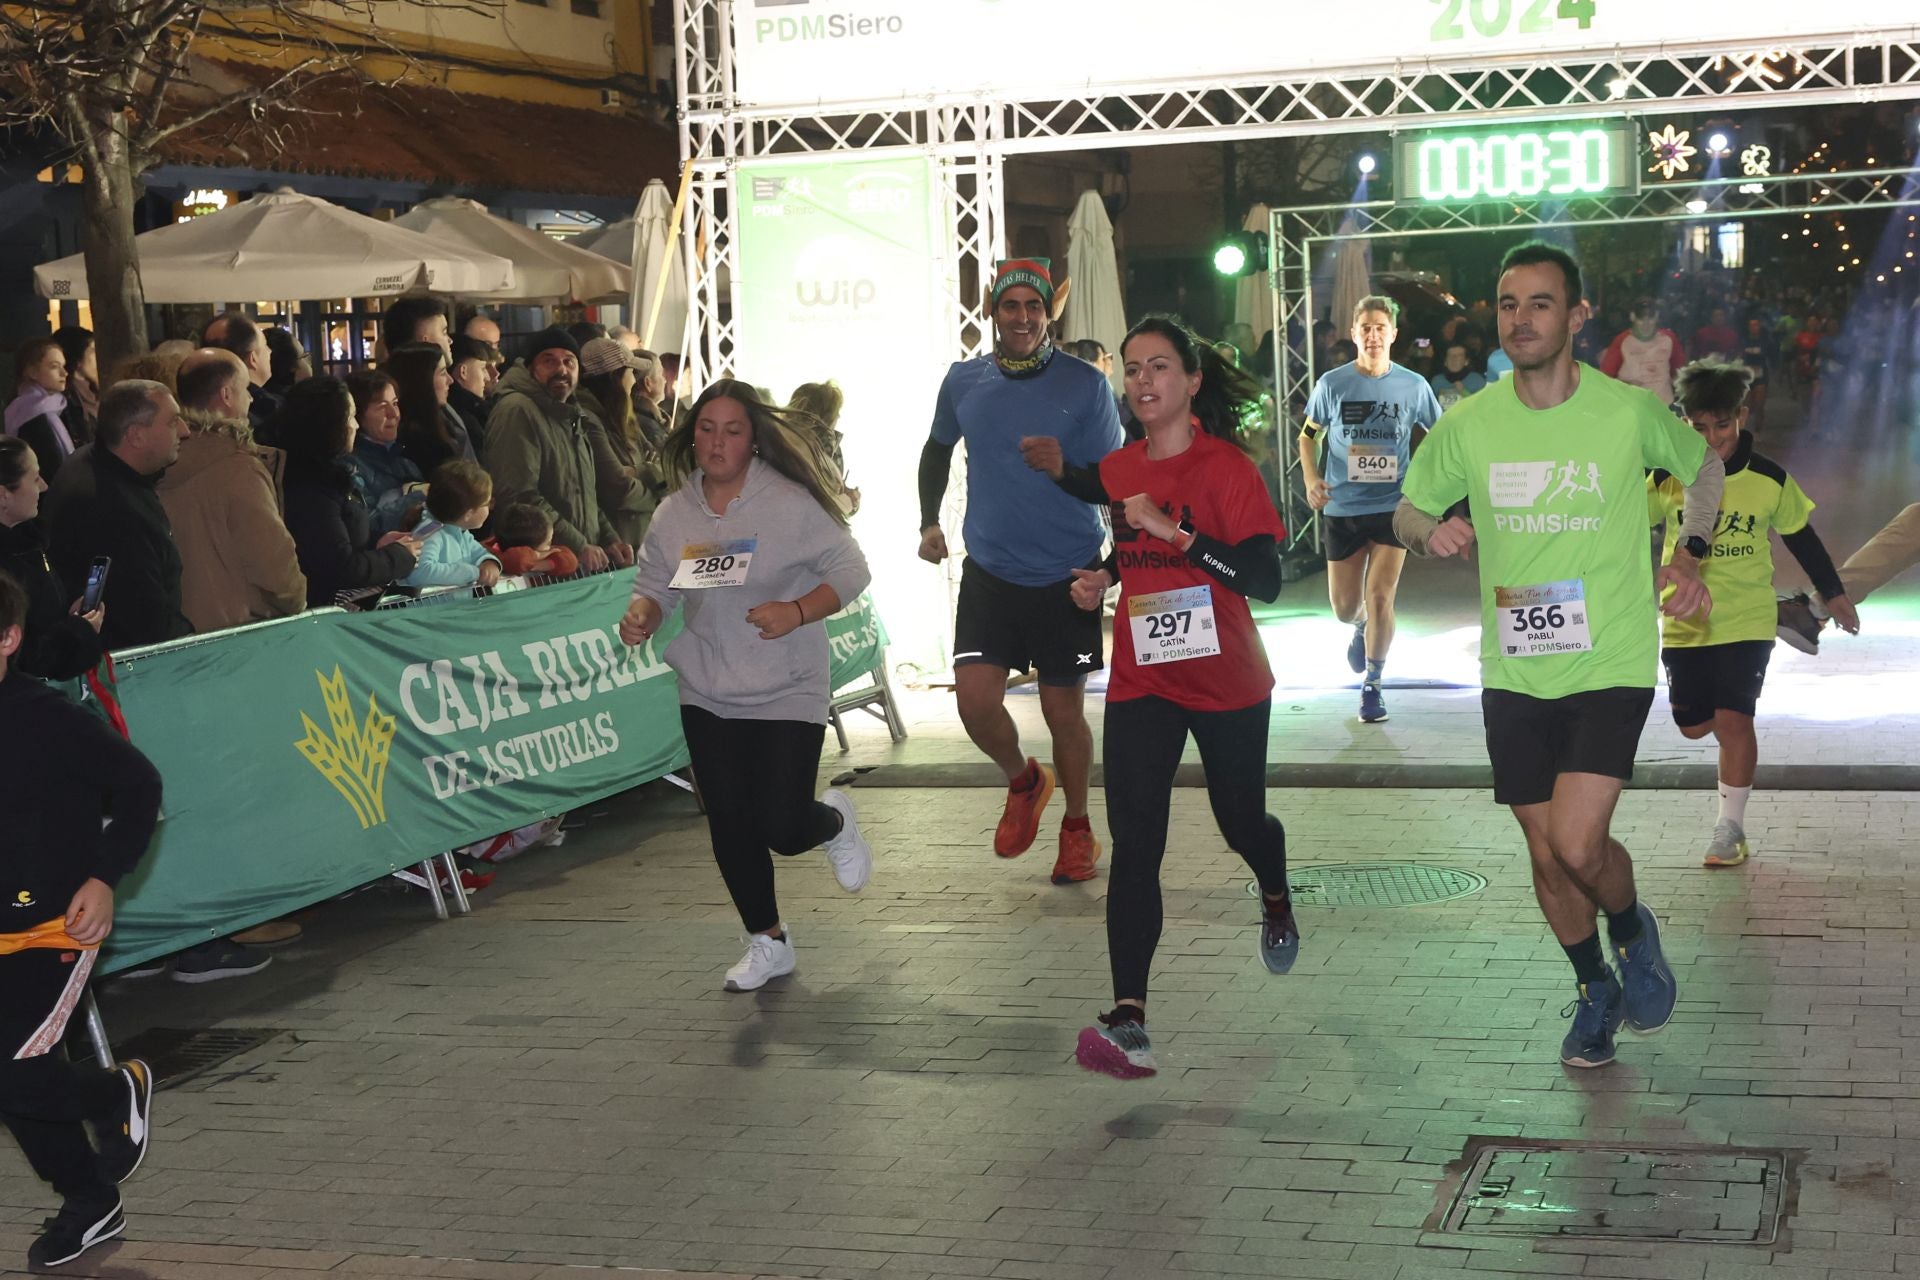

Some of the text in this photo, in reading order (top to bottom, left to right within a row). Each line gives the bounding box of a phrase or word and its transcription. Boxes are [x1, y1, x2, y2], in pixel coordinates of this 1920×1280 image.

[755, 13, 903, 43] PDMSiero
[1430, 0, 1597, 41] 2024
[1418, 129, 1609, 201] 00:08:30
[1358, 456, 1388, 469] 840
[1494, 513, 1601, 533] PDMSiero
[692, 555, 735, 574] 280
[1202, 552, 1237, 578] KIPRUN
[1145, 610, 1192, 639] 297
[1510, 604, 1565, 632] 366
[1527, 631, 1555, 641] PABLI
[1530, 642, 1582, 653] PDMSiero
[1162, 646, 1211, 660] PDMSiero
[400, 651, 530, 736] CAJA
[422, 710, 620, 800] DE ASTURIAS
